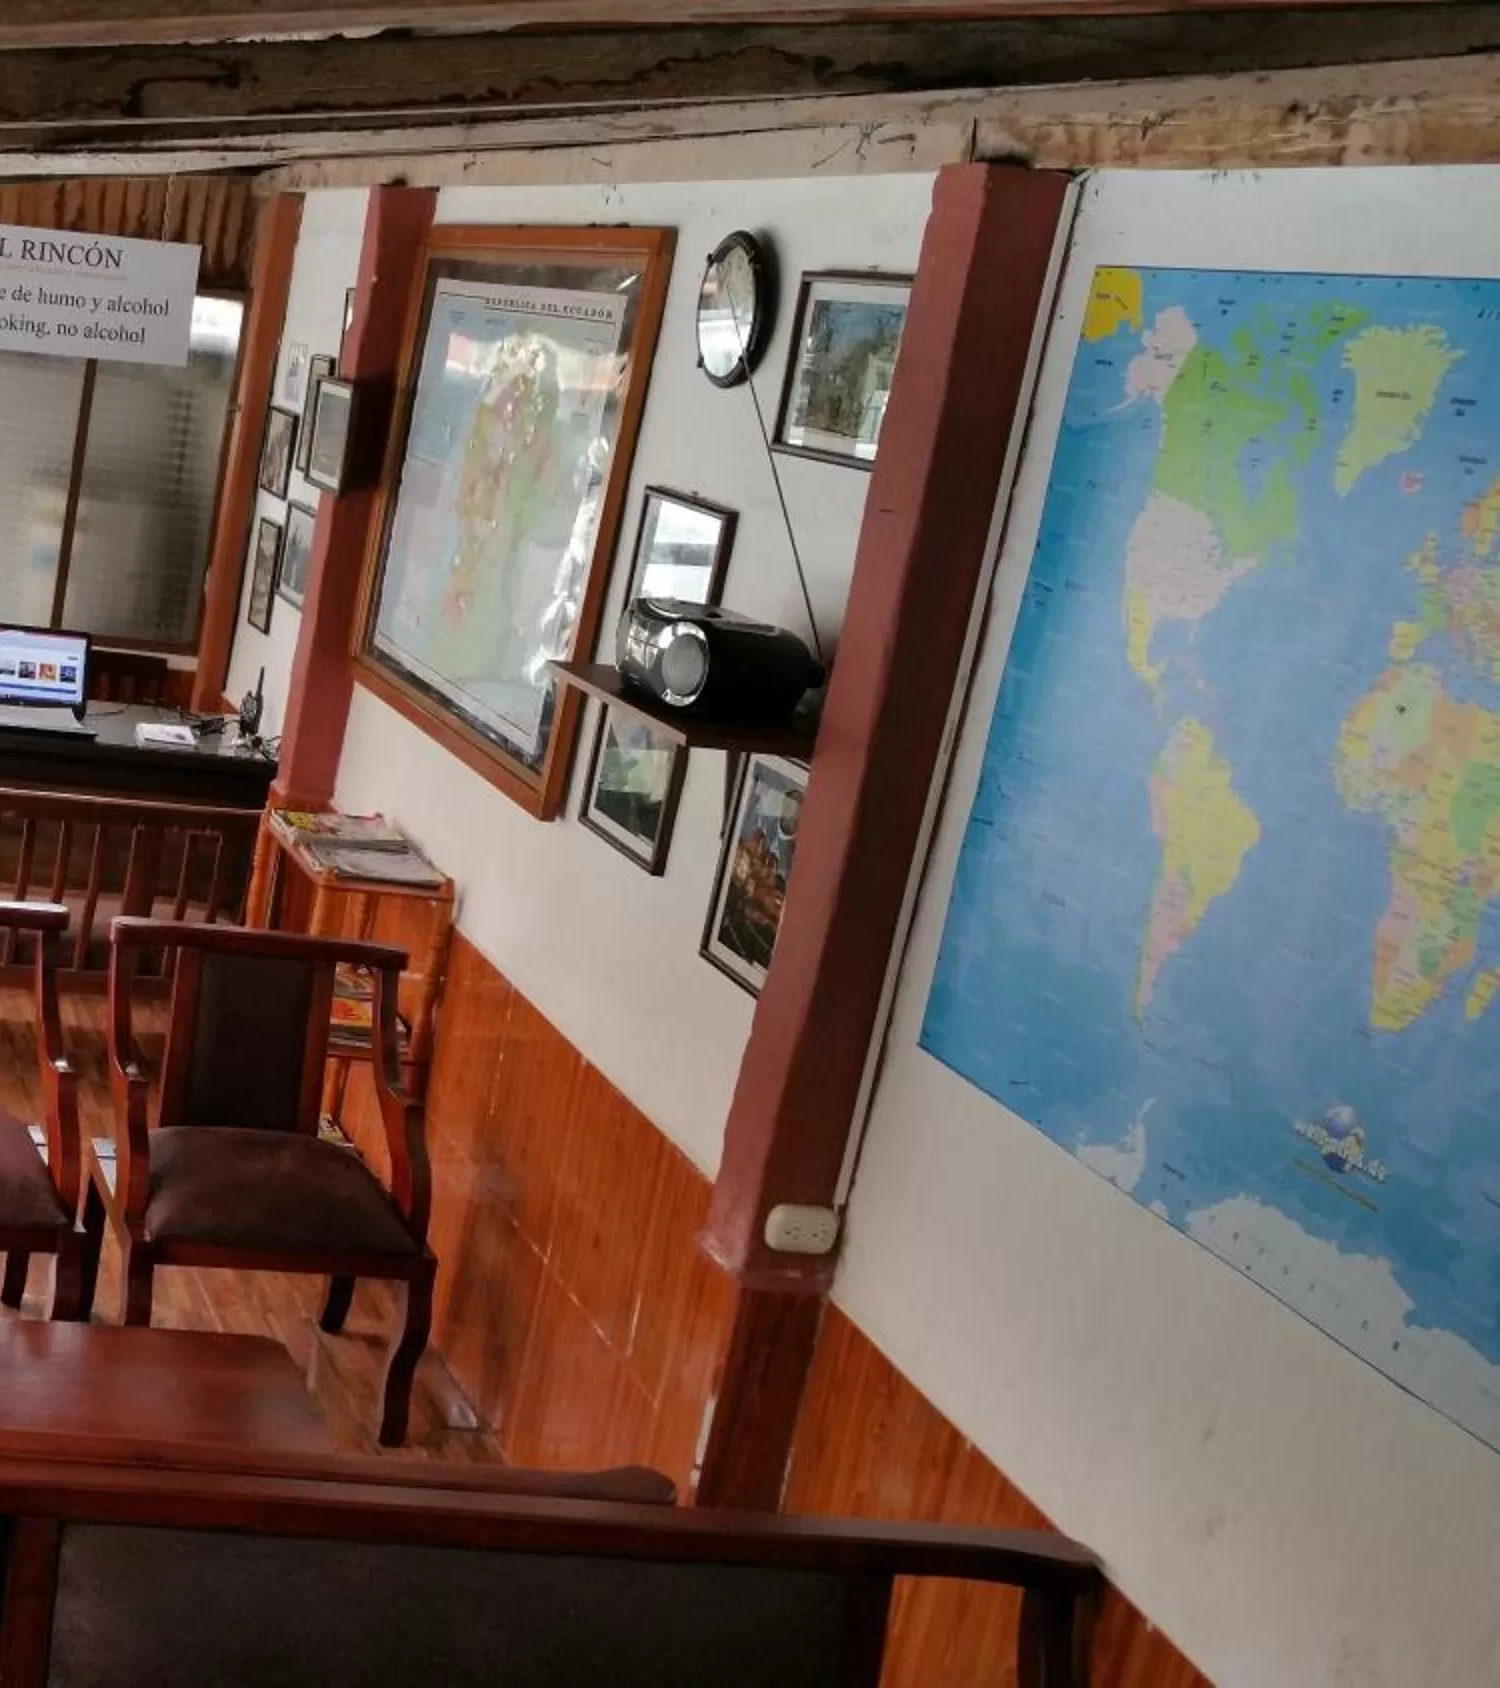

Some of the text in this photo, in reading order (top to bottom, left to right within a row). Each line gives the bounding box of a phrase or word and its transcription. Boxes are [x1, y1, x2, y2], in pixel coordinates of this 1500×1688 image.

[21, 238, 125, 269] RINCÓN
[11, 284, 33, 303] de
[37, 287, 87, 309] humo
[89, 297, 102, 314] y
[107, 294, 170, 316] alcohol
[57, 322, 79, 337] no
[83, 321, 146, 344] alcohol
